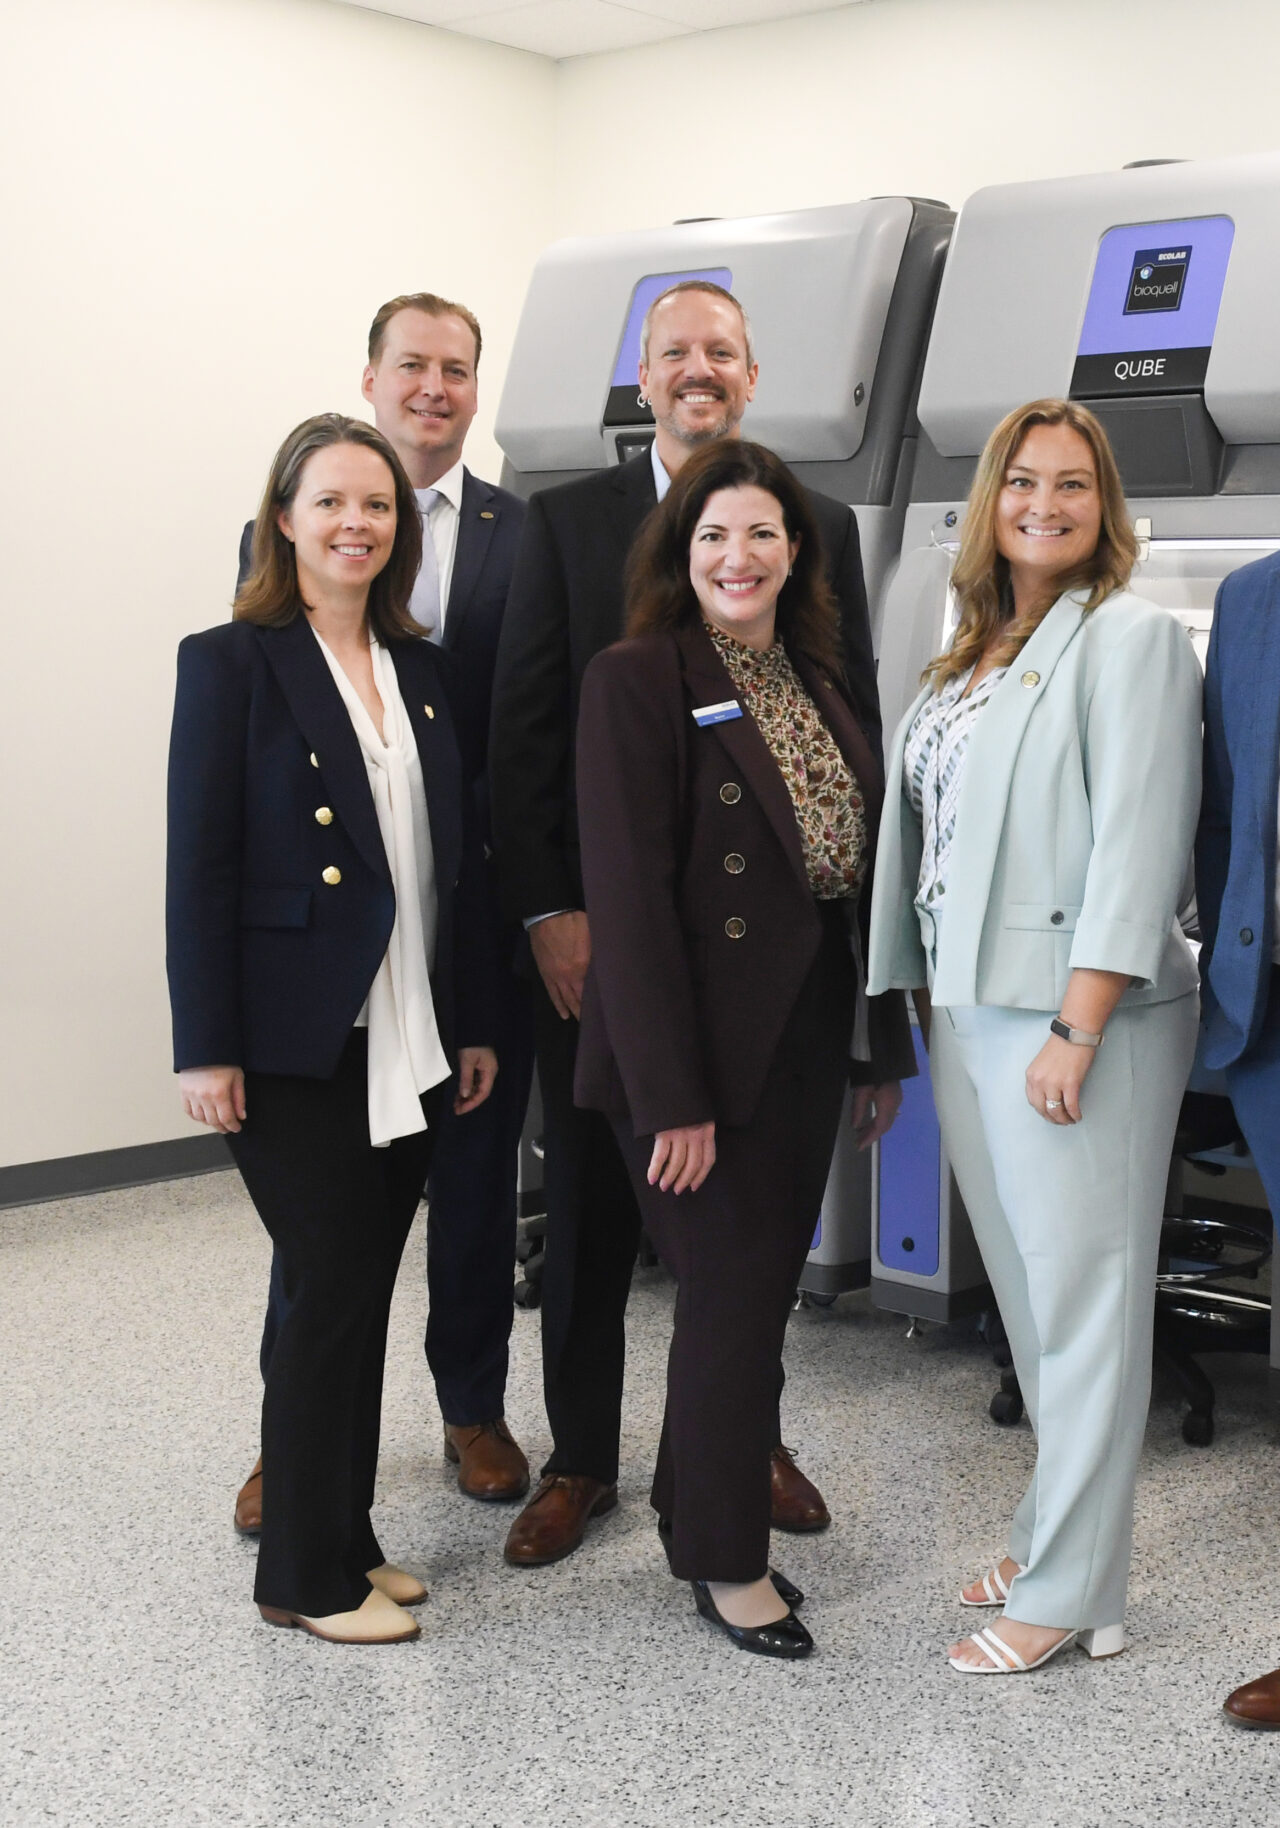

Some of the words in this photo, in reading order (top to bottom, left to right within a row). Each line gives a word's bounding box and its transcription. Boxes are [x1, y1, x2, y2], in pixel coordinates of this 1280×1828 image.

[1158, 251, 1187, 261] ECOLAB
[1133, 281, 1178, 298] bioquell
[1114, 358, 1167, 380] QUBE
